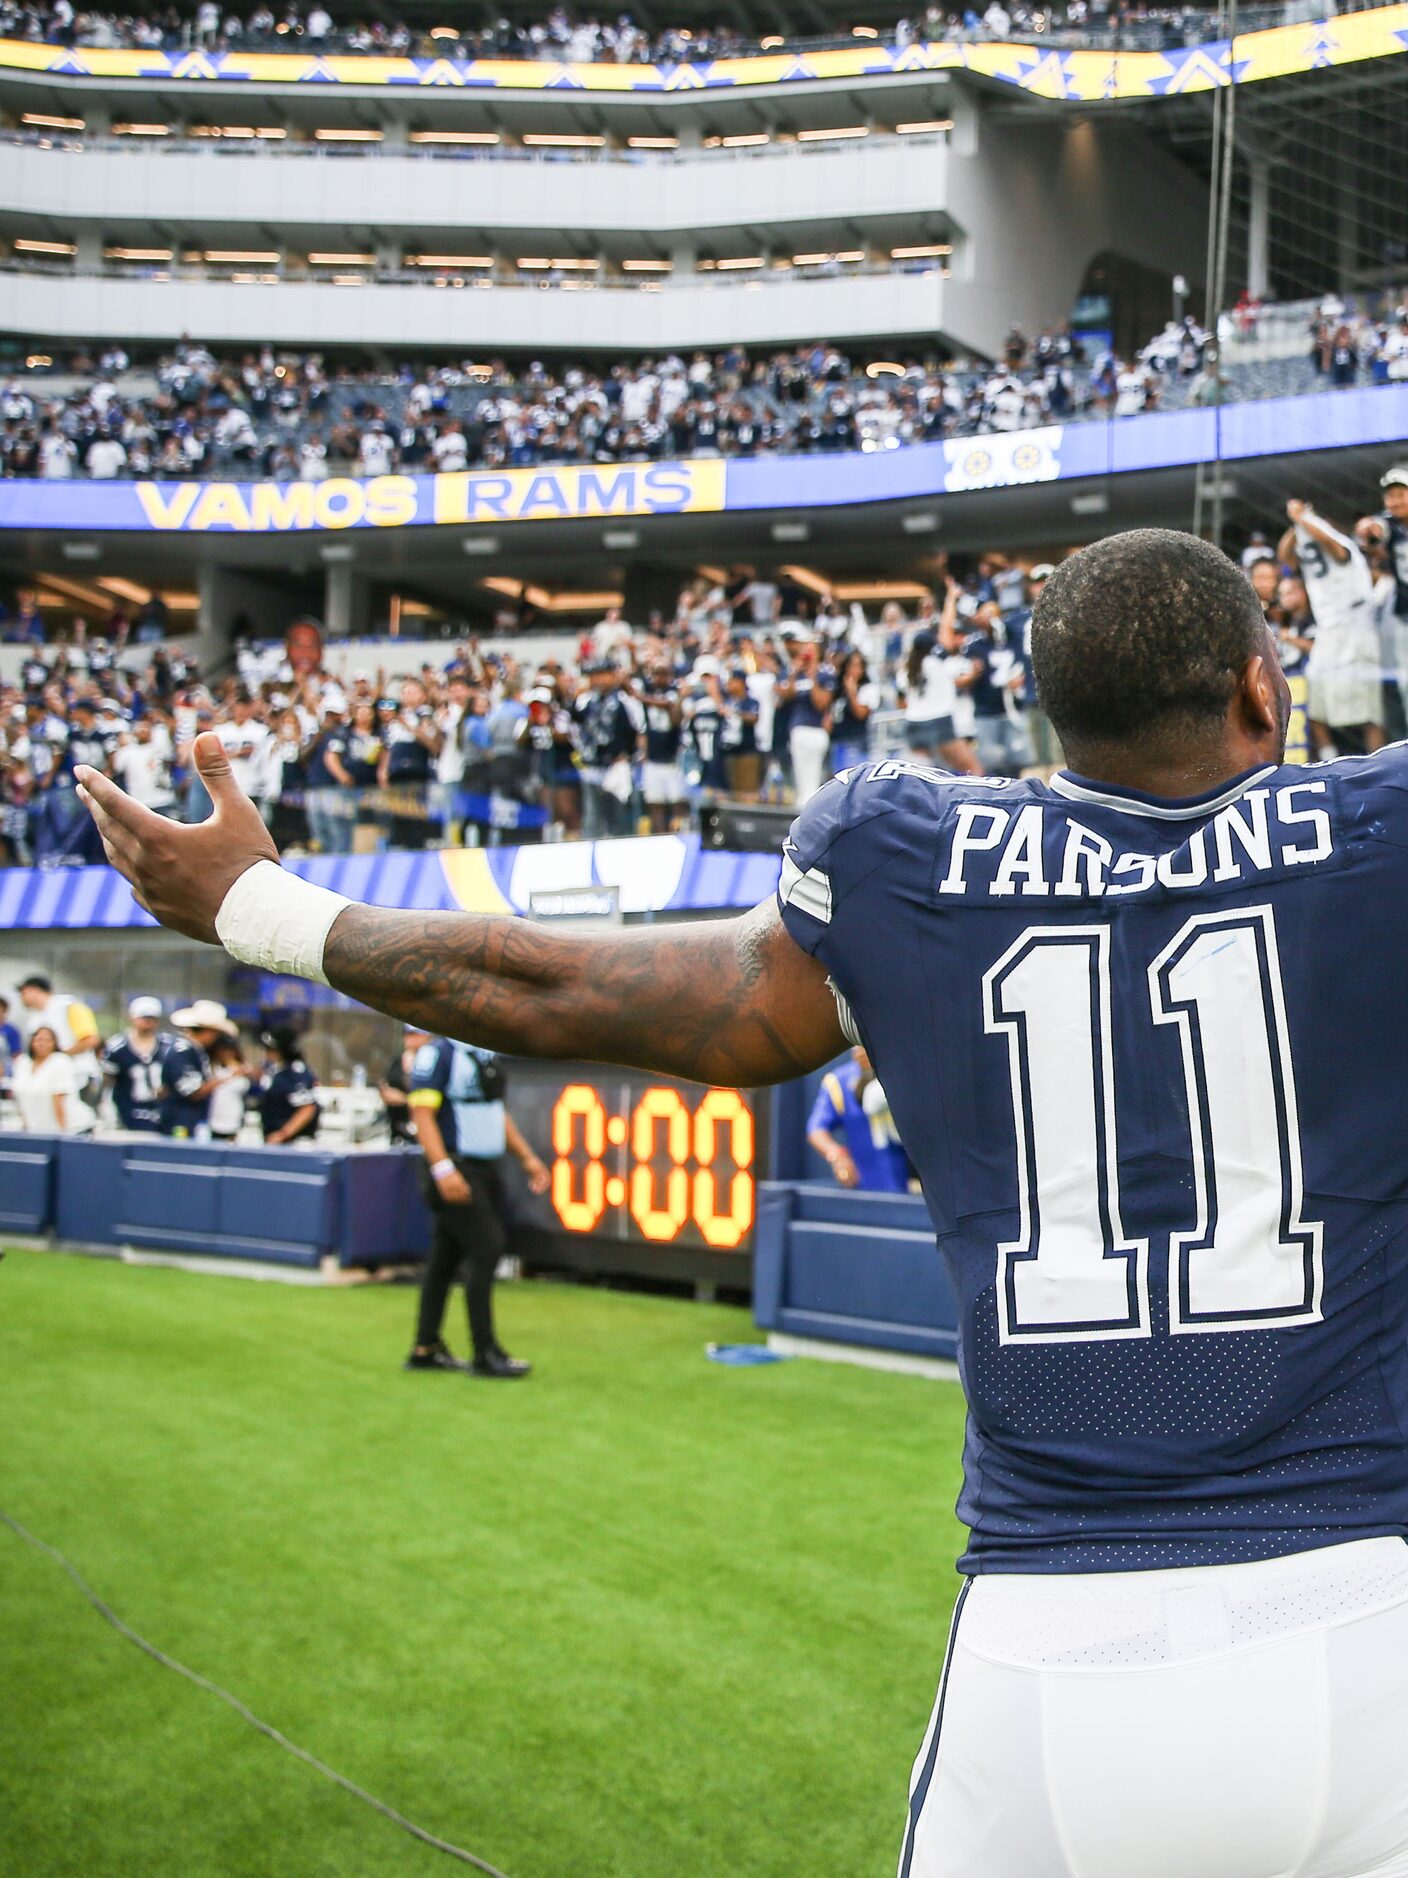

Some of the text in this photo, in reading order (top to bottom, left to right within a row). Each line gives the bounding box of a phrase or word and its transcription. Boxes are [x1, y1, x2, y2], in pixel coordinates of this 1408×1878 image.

[136, 463, 693, 531] VAMOS RAMS
[938, 779, 1334, 897] PARSONS
[550, 1083, 756, 1249] 0:00
[982, 903, 1325, 1346] 11
